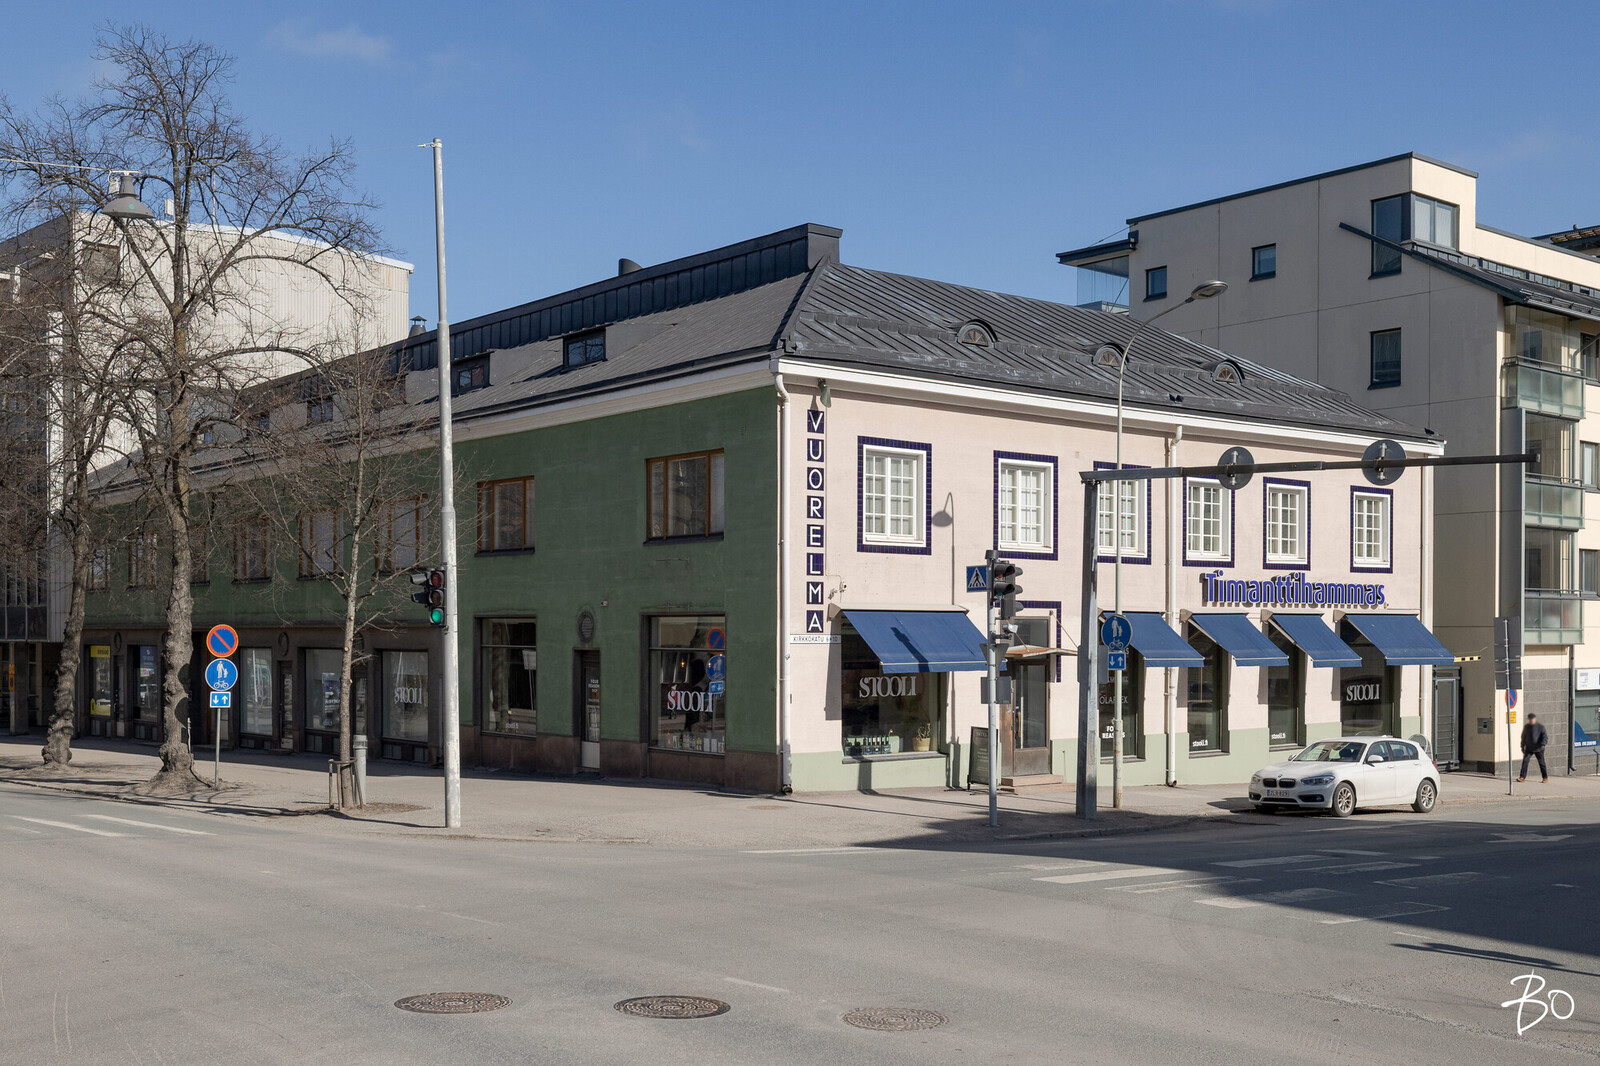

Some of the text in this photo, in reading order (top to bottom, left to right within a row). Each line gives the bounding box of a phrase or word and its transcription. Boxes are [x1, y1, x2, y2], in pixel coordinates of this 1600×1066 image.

[808, 411, 823, 631] VUORELMA
[1205, 570, 1385, 605] Timanttihammas
[859, 676, 917, 698] STOOLI
[1346, 684, 1380, 702] STOOLI
[667, 690, 713, 712] STOOLI
